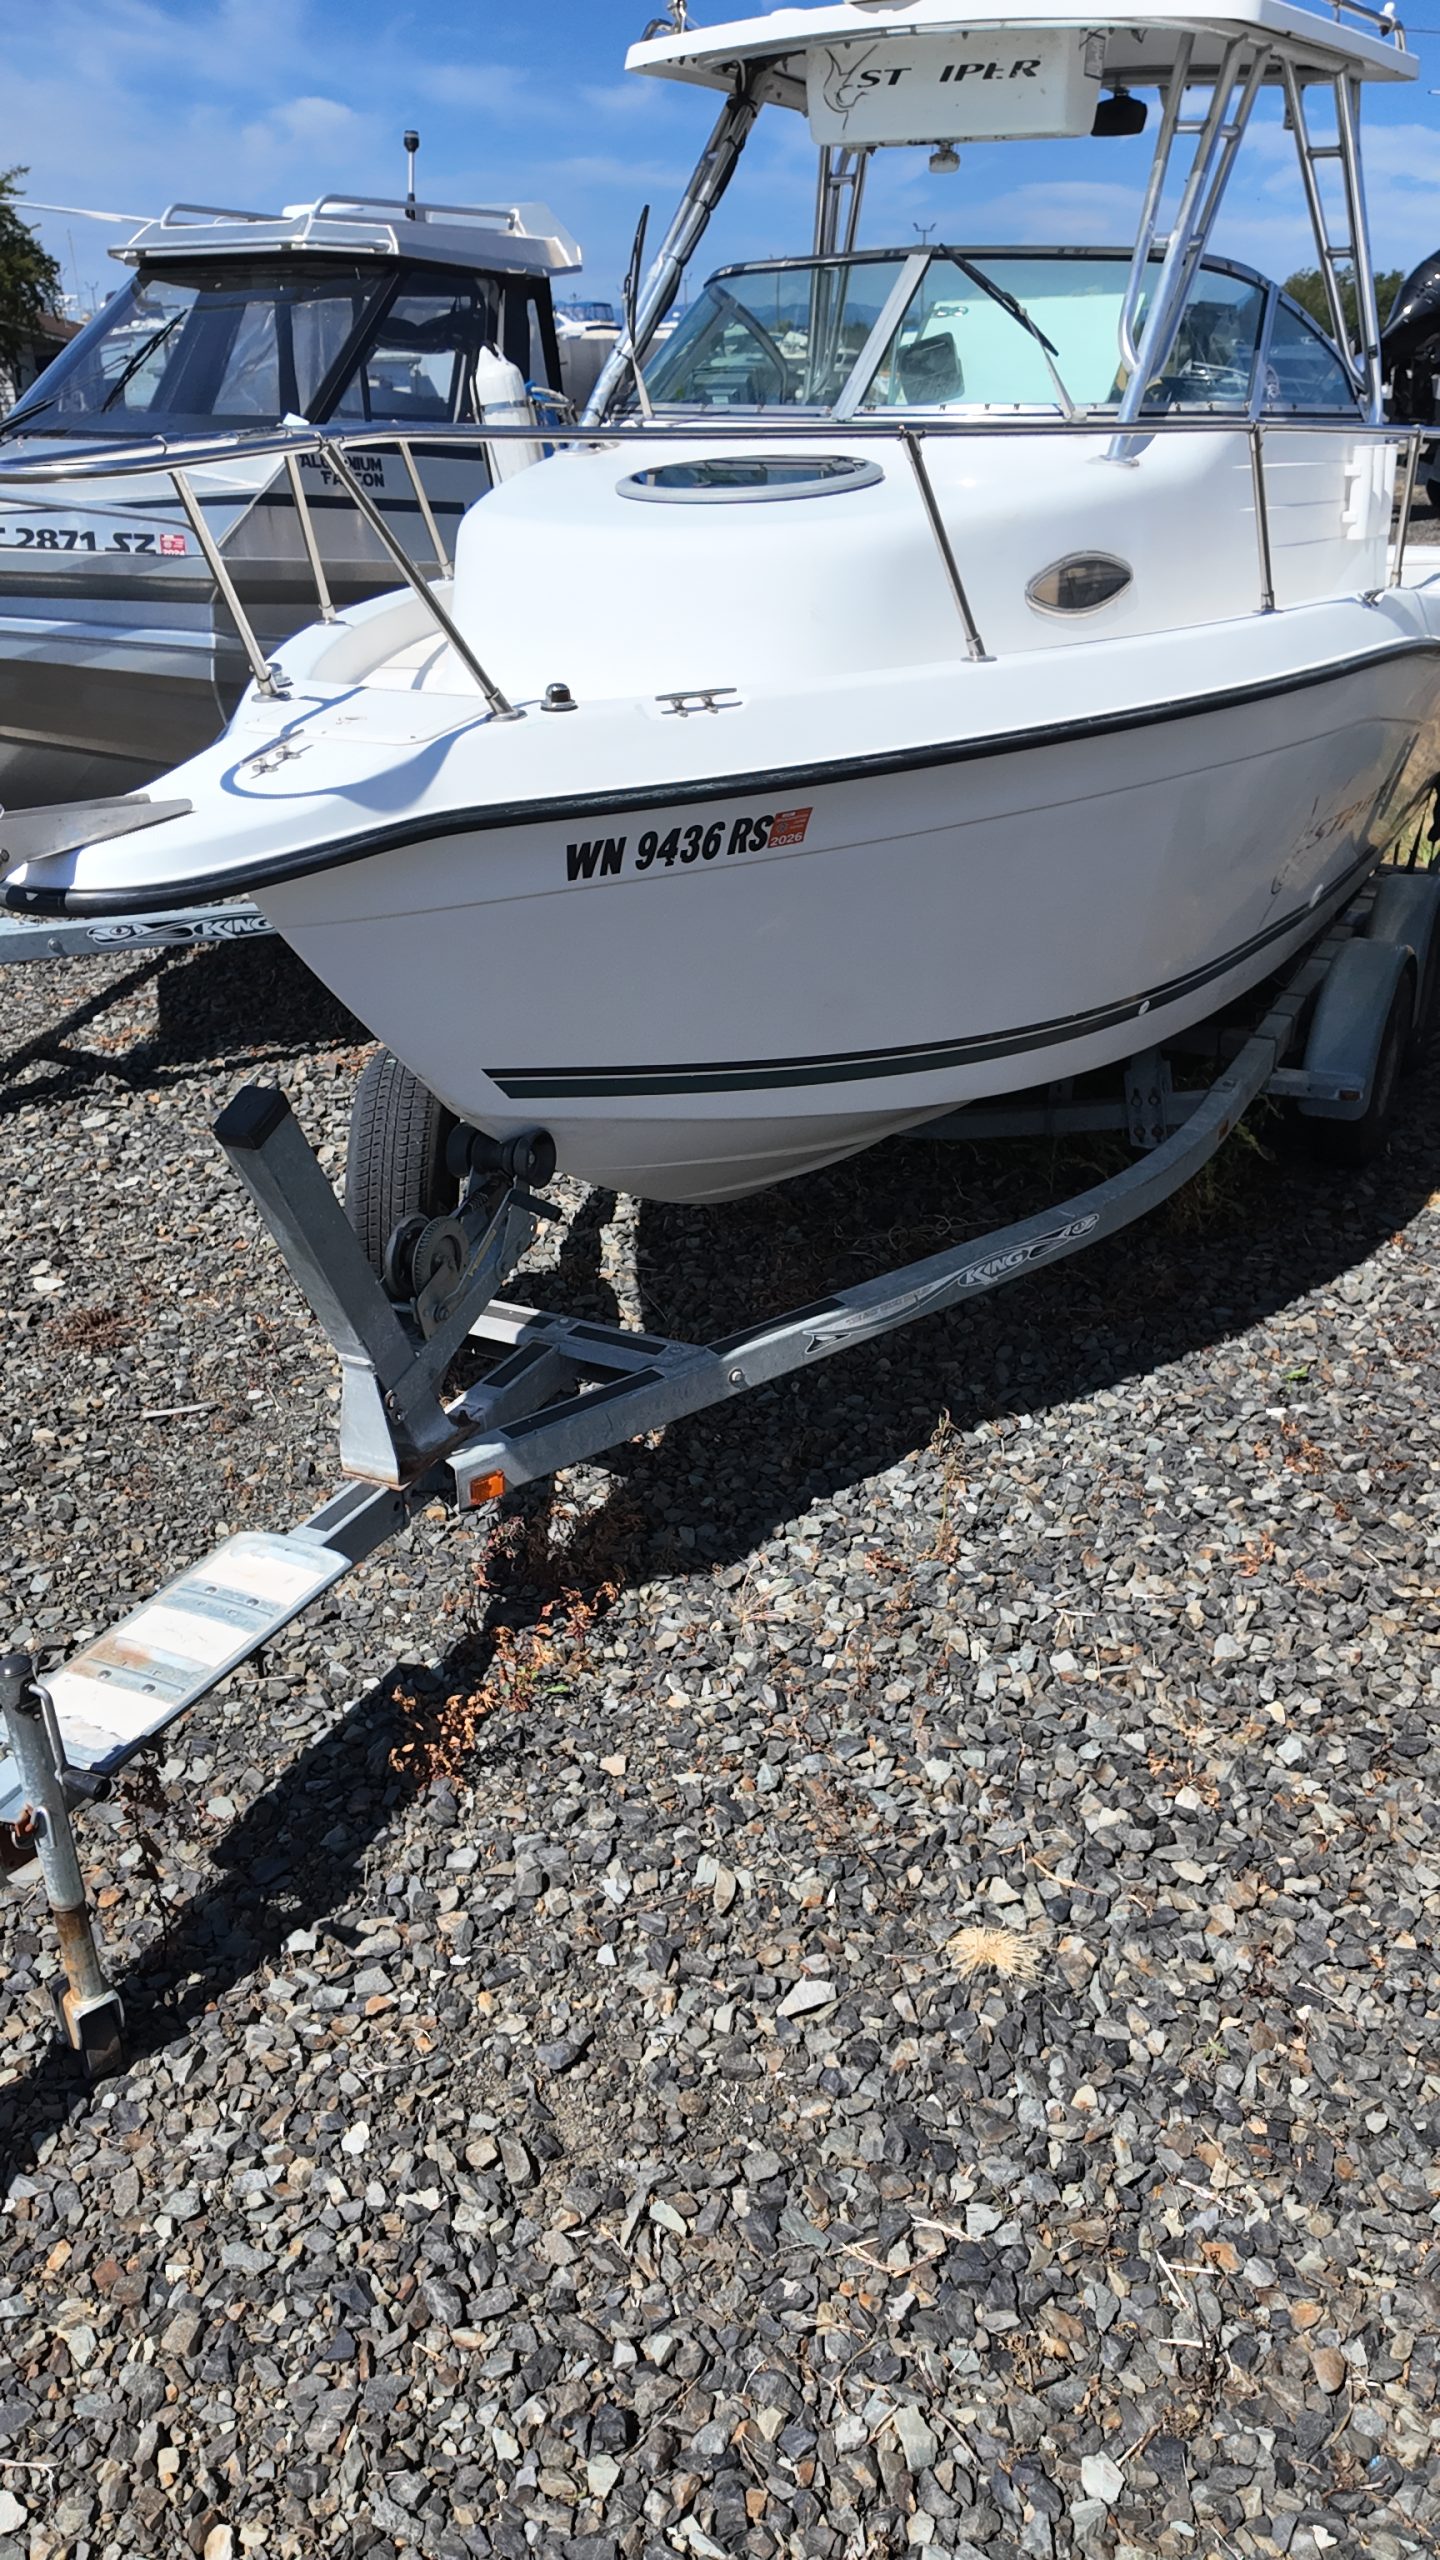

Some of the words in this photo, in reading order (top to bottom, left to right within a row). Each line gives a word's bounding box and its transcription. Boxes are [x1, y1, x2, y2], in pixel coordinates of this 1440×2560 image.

[16, 528, 96, 550] 2871
[105, 533, 156, 554] SZ
[566, 837, 627, 881] WN
[635, 821, 726, 870] 9436
[727, 814, 775, 855] RS
[770, 832, 803, 846] 2026
[202, 917, 274, 938] KING
[965, 1251, 1024, 1285] KING
